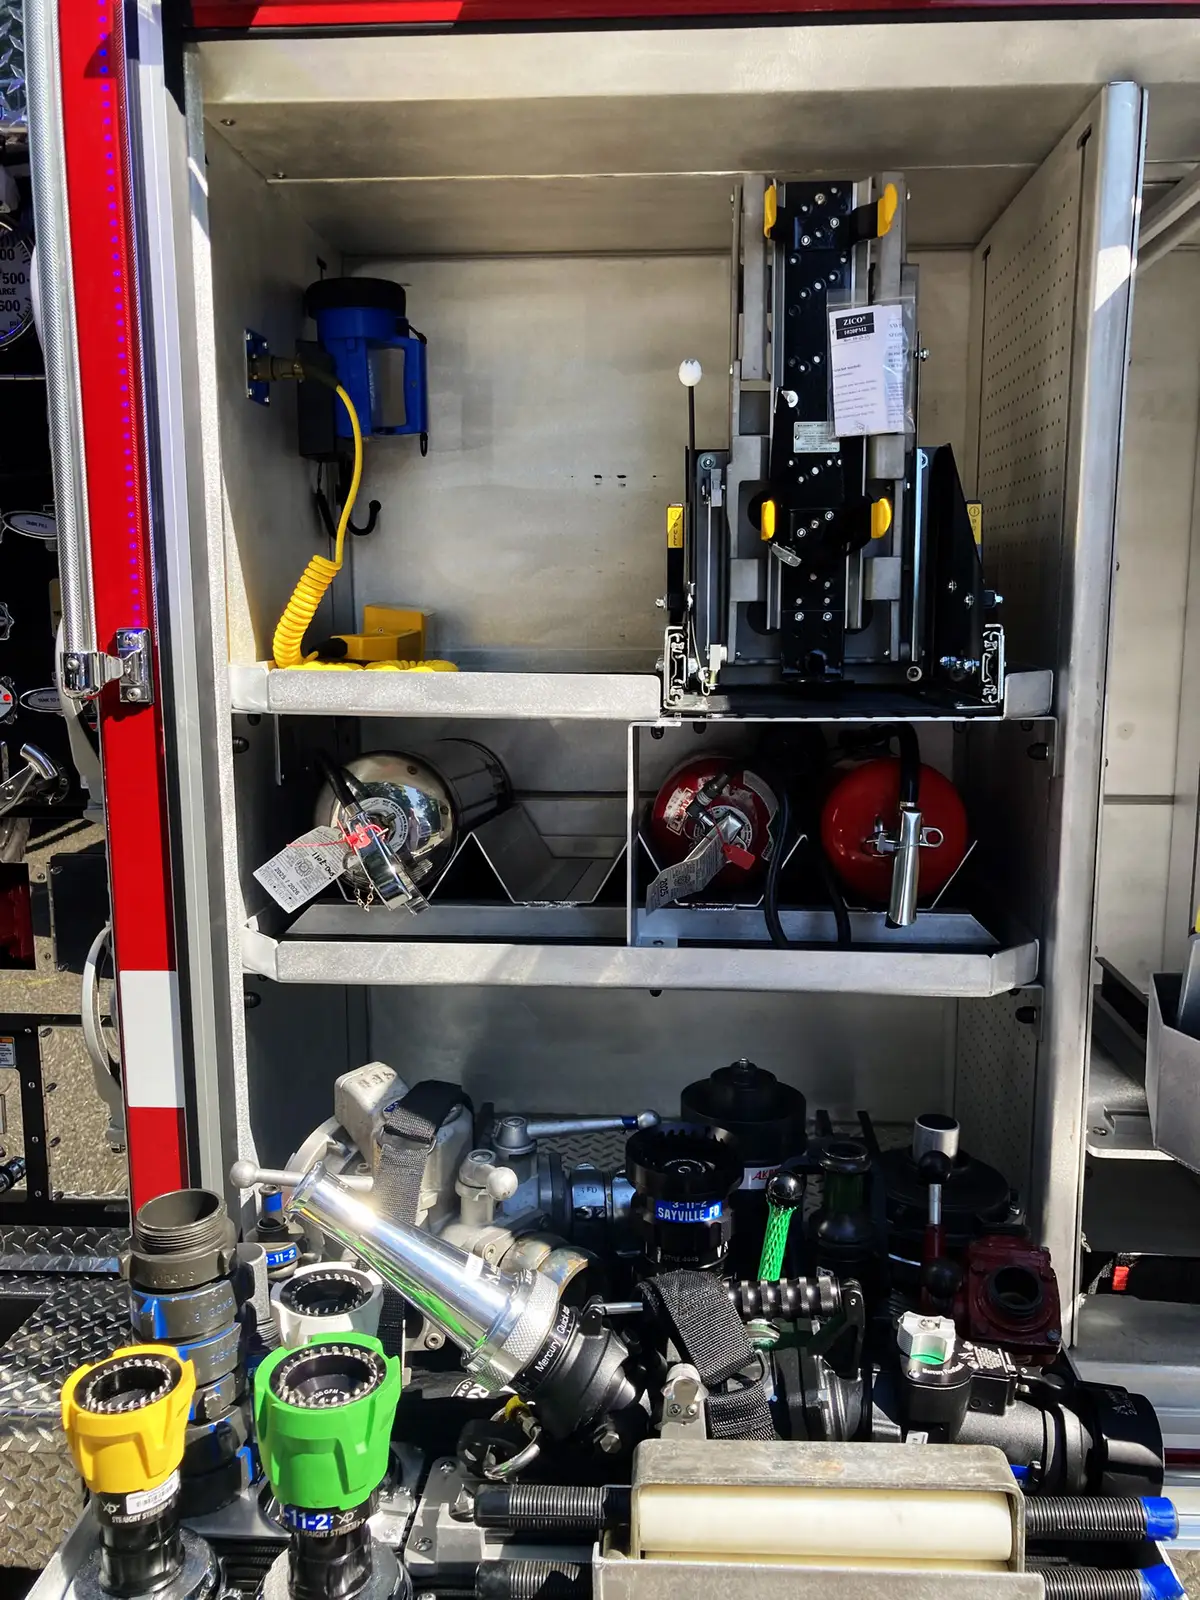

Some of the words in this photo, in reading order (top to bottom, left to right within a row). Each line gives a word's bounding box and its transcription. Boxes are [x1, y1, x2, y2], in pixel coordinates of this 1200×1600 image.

[2, 272, 26, 285] 500
[274, 867, 287, 880] 2025
[287, 883, 300, 895] 2026
[657, 1206, 705, 1222] SAYVILLE
[709, 1204, 720, 1218] FD
[534, 1338, 562, 1372] Mercury
